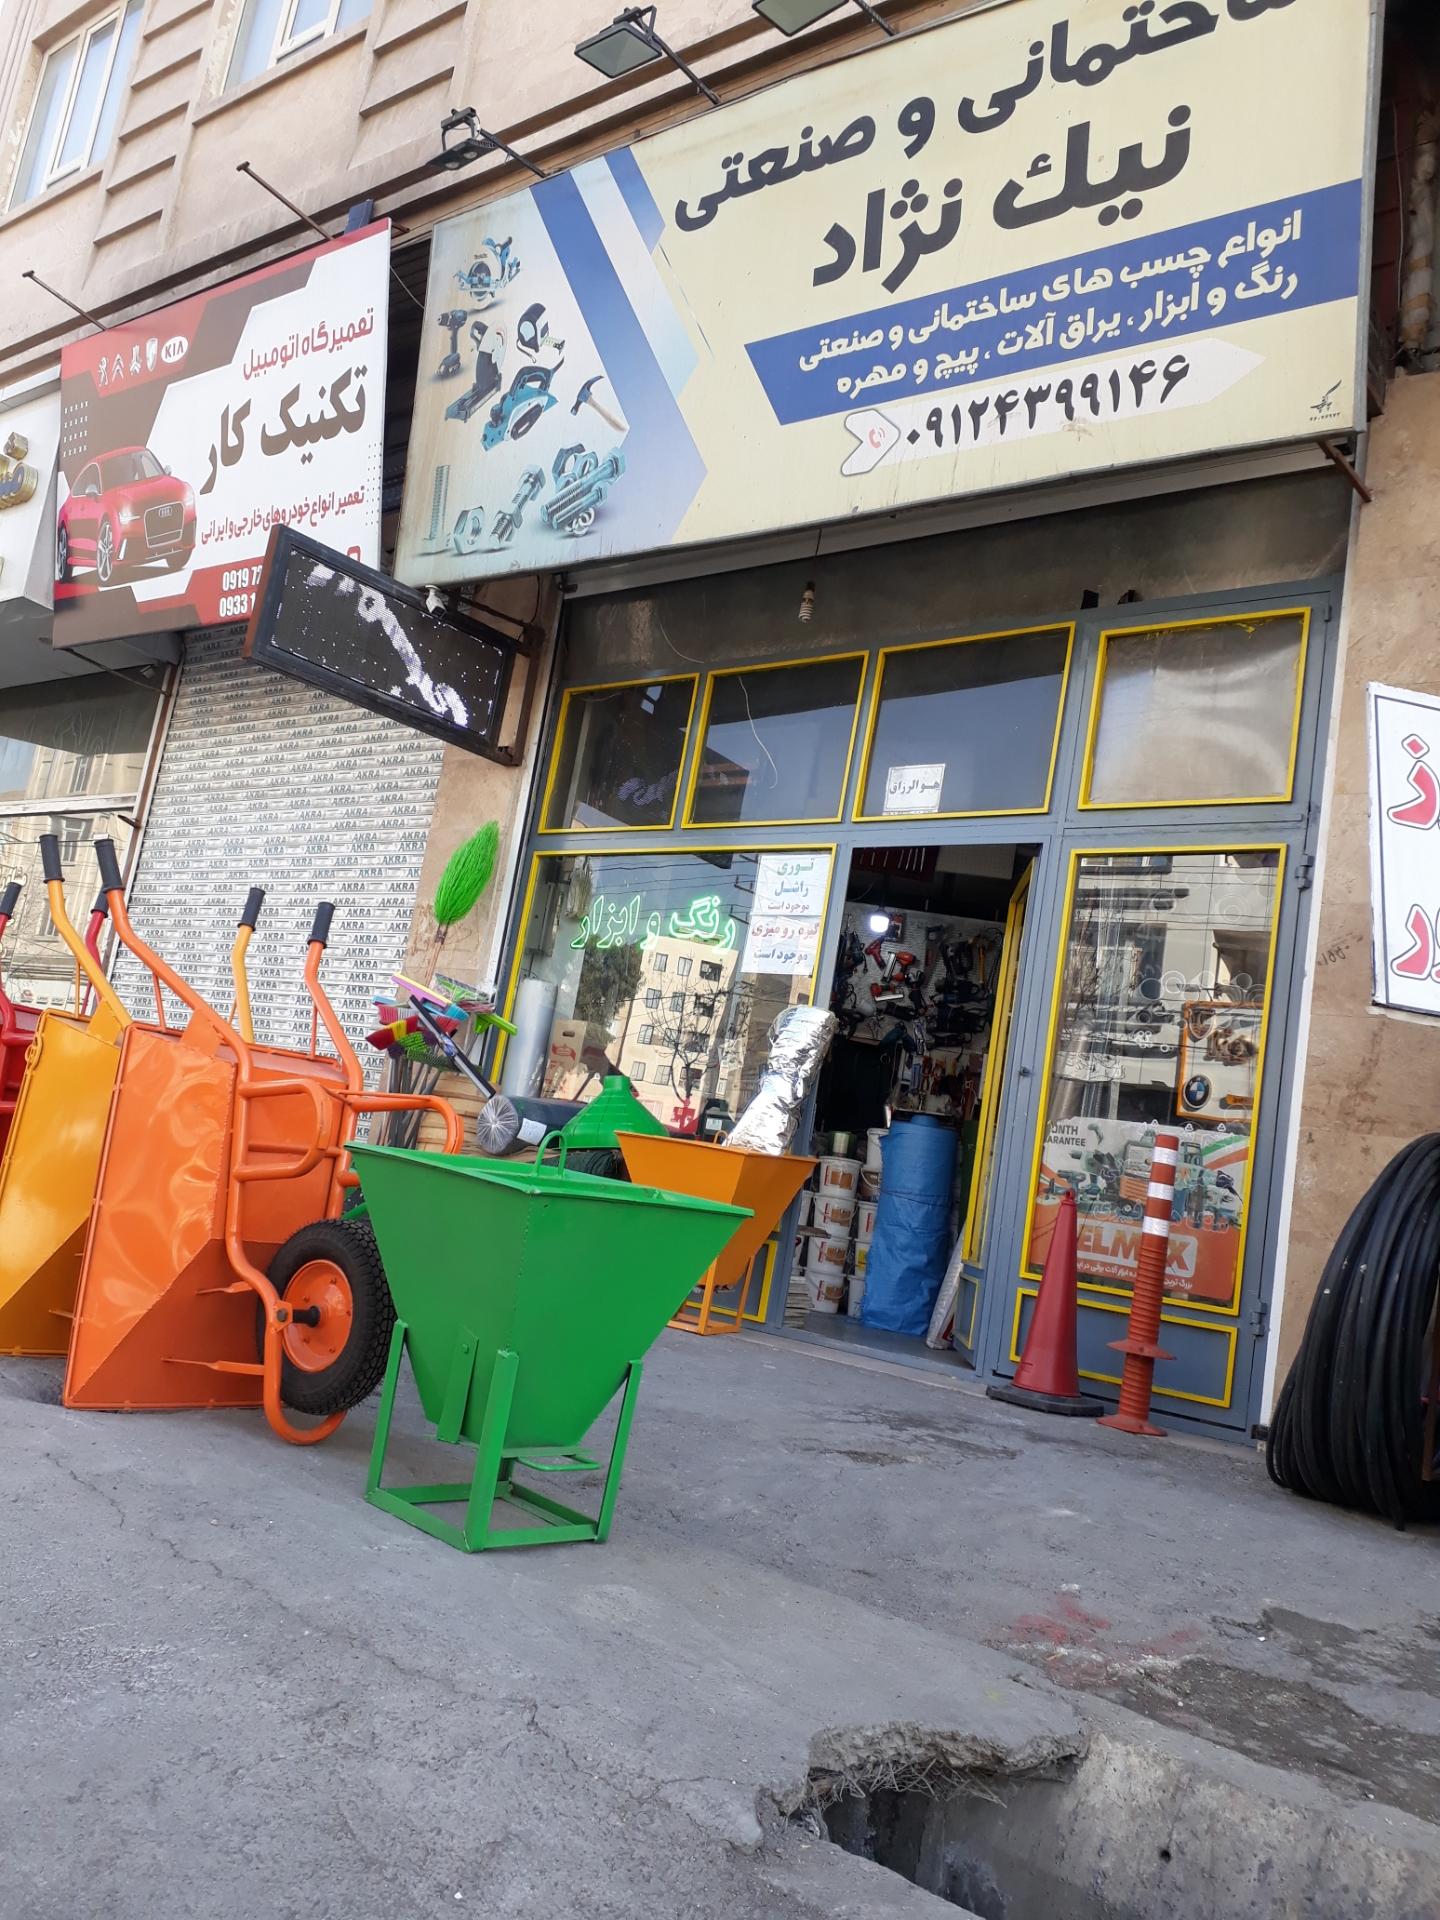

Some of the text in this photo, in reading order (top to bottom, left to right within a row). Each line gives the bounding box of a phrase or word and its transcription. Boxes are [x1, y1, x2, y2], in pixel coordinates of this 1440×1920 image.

[896, 95, 937, 159] و
[674, 114, 877, 233] صنعتی
[812, 176, 965, 295] نژاد
[798, 208, 1303, 373] انواع چسب های ساختمانی و صنعتی
[1234, 260, 1300, 301] رنگ
[1206, 285, 1228, 317] و
[1058, 307, 1122, 351] یراق
[243, 306, 375, 382] تعمیرگاه اتومبیل
[912, 357, 930, 386] و
[932, 345, 980, 380] پیچ
[836, 362, 908, 400] مهره
[200, 364, 369, 496] تکنیک کار
[310, 490, 336, 529] انواع
[335, 485, 366, 517] تعمیر
[222, 566, 249, 592] 0919
[219, 592, 249, 618] 0933
[270, 696, 292, 706] AKRA
[291, 728, 313, 740] AKRA
[277, 741, 299, 753] AKRA
[305, 750, 327, 761] AKRA
[349, 746, 373, 757] AKRA
[269, 766, 429, 788] AKRA AKRA AKRA AKRA
[291, 763, 312, 775] AKRA
[333, 759, 358, 771] AKRA
[327, 784, 352, 795] AKRA
[172, 794, 404, 816] AKRA AKRA AKRA AKRA AKRA
[218, 805, 417, 825] AKRA AKRA AKRA AKRA AKRA
[289, 823, 311, 834] AKRA
[333, 820, 357, 830] AKRA
[264, 836, 286, 846] AKRA
[352, 832, 377, 842] AKRA
[262, 846, 284, 856] AKRA
[304, 845, 328, 855] AKRA
[208, 860, 228, 870] AKRA
[247, 857, 269, 867] AKRA
[334, 857, 358, 867] AKRA
[381, 855, 407, 865] AKRA
[139, 882, 415, 894] AKRA AKRA AKRA AKRA AKRA AKRA
[142, 906, 371, 918] AKRA AKRA AKRA AKRA
[379, 897, 405, 907] AKRA
[137, 917, 364, 931] AKRA AKRA AKRA AKRA
[570, 894, 737, 955] رنگ و ابزار
[146, 929, 378, 944] AKRA AKRA AKRA AKRA
[175, 941, 370, 957] AKRA AKRA AKRA
[182, 952, 201, 962] AKRA
[262, 956, 284, 966] AKRA
[1046, 1135, 1087, 1147] ARANTEE
[1077, 1225, 1190, 1272] ELMX
